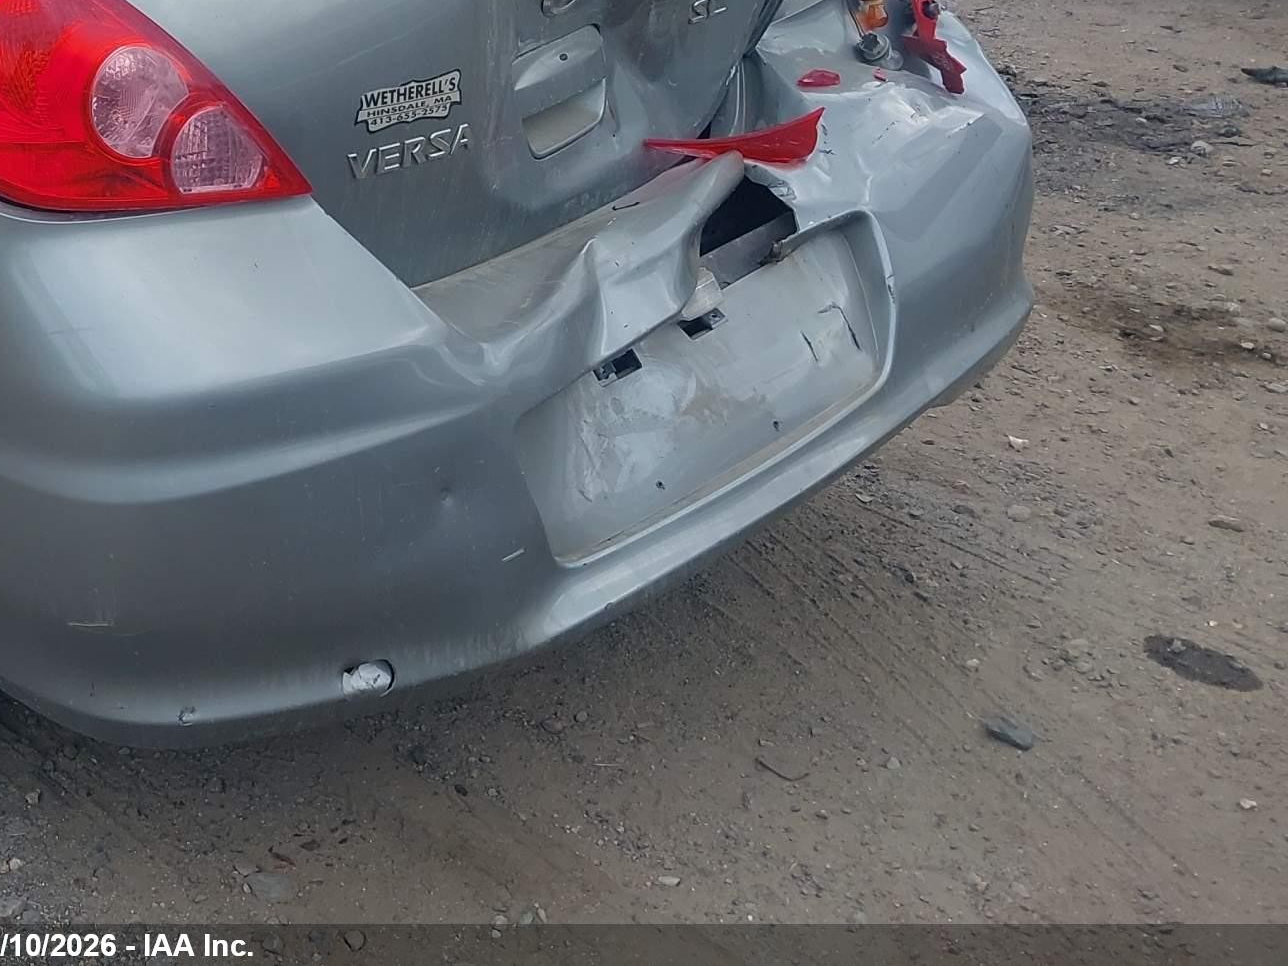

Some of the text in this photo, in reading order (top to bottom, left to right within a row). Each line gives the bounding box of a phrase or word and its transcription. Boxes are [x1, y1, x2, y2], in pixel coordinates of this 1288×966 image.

[363, 76, 456, 109] WETHERELL'S
[367, 94, 452, 118] HINSDALE, MA
[370, 103, 448, 126] 413-655-2575
[347, 122, 470, 179] VERSA
